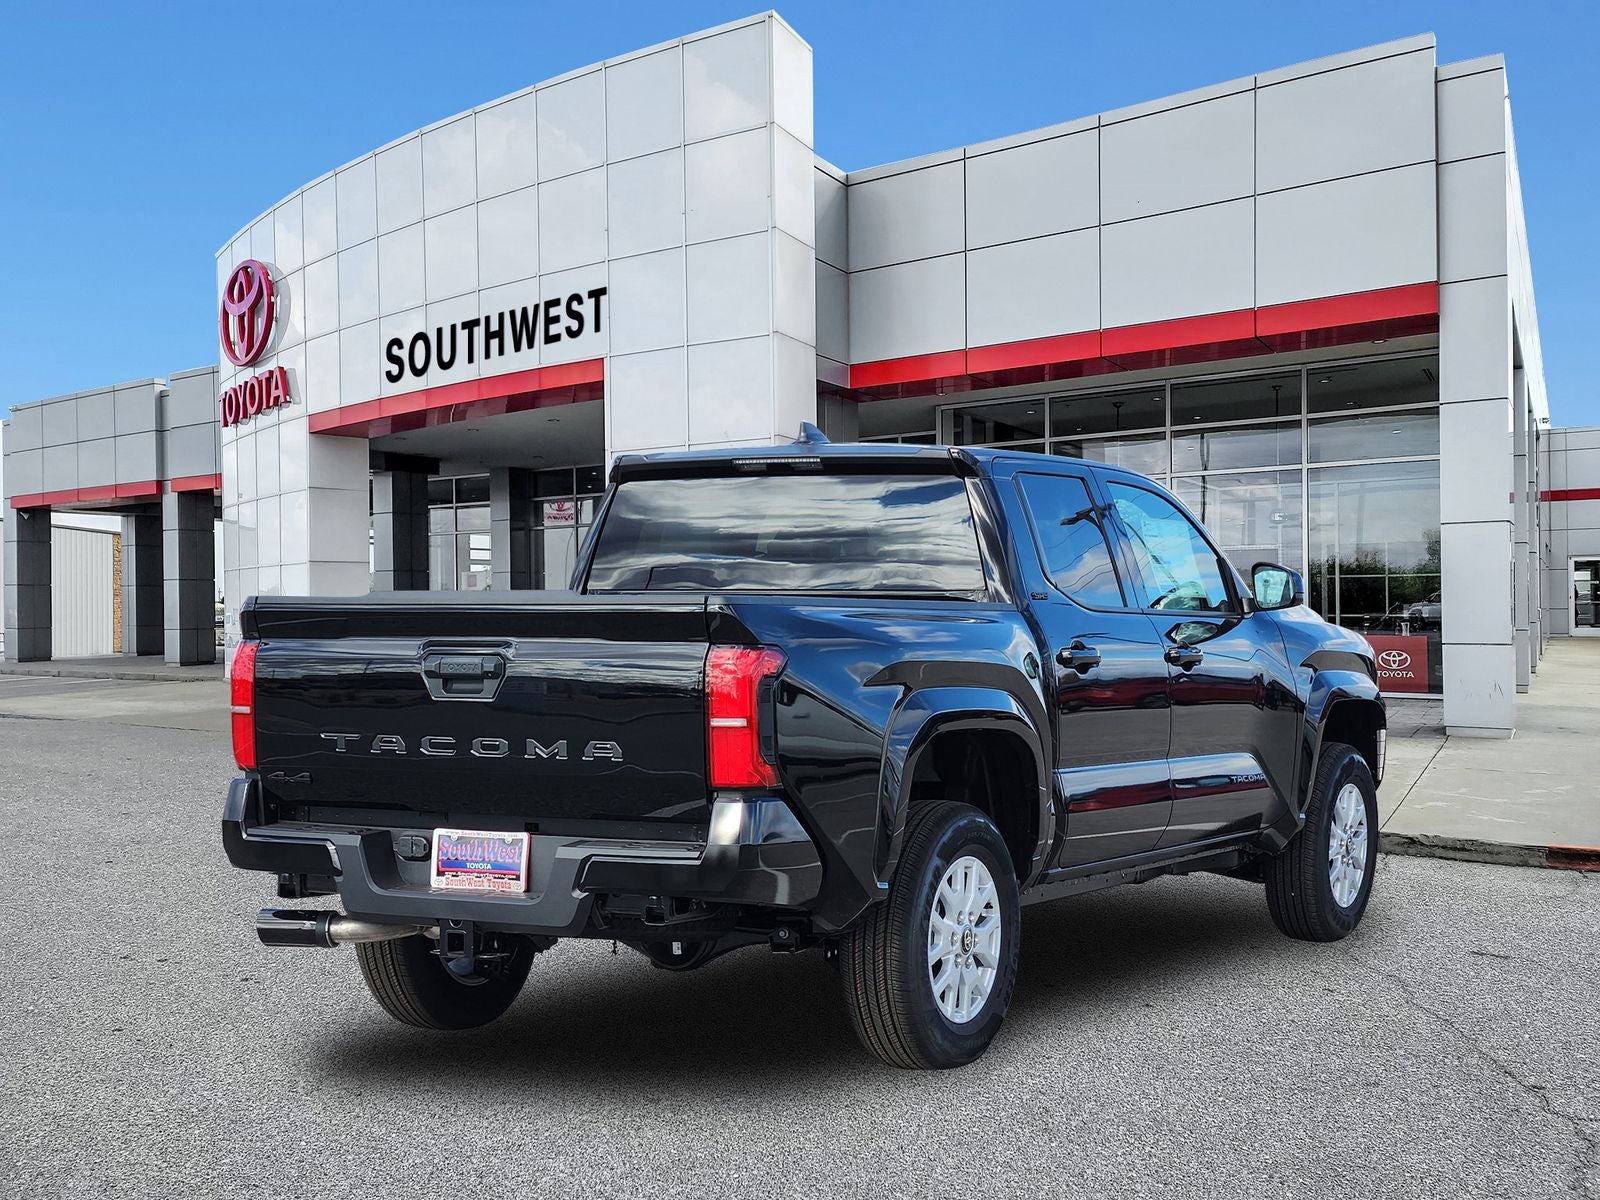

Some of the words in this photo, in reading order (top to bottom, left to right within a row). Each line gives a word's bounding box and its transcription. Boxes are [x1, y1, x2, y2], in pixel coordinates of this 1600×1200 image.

[385, 286, 607, 383] SOUTHWEST
[219, 366, 292, 427] TOYOTA
[442, 663, 482, 673] TOYOTA
[320, 733, 623, 761] TACOMA
[1231, 774, 1266, 783] TACOMA
[466, 862, 492, 870] TOYOTA
[487, 879, 512, 890] Toyota
